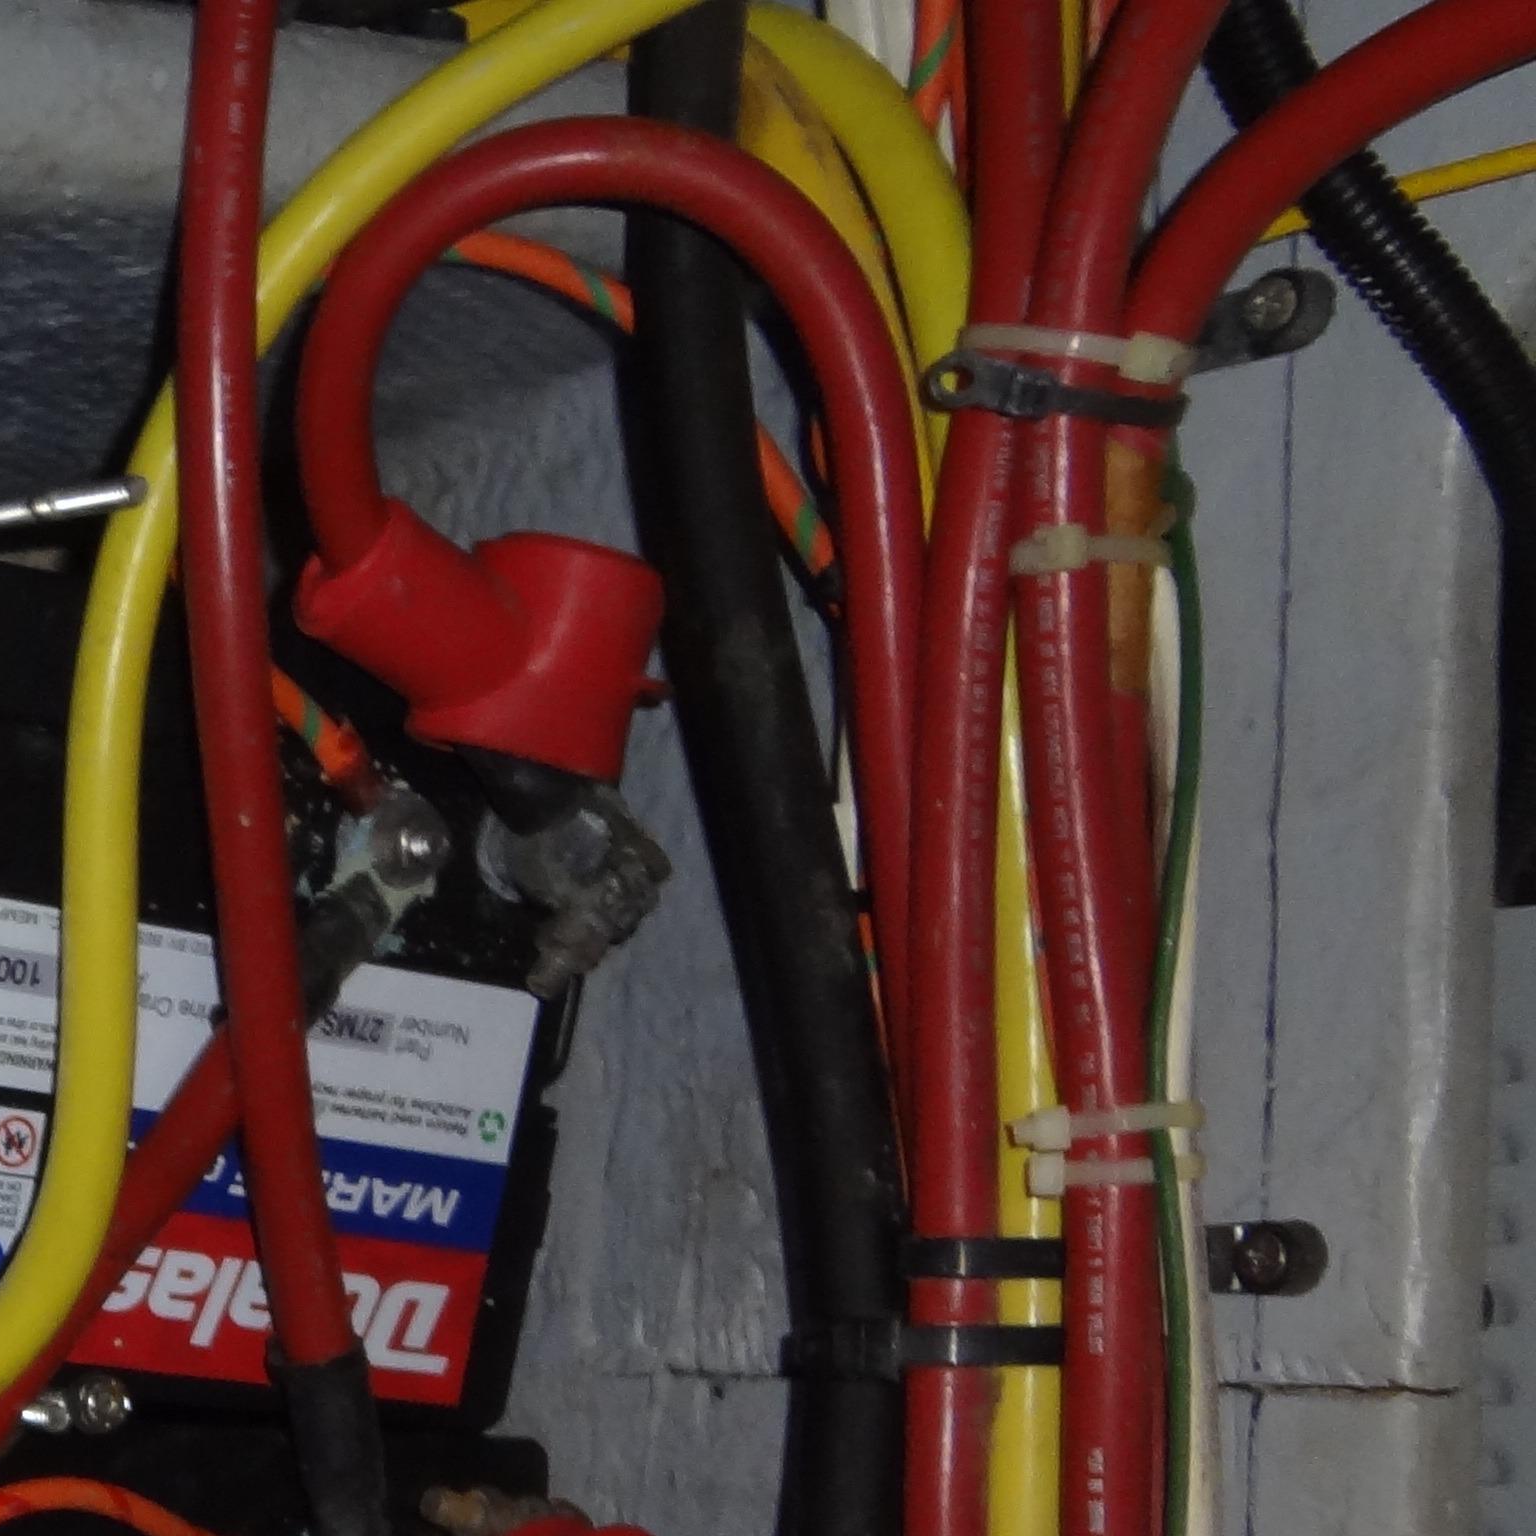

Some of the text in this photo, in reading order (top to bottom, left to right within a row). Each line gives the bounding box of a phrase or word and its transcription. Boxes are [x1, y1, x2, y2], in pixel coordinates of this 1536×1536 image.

[397, 1014, 472, 1048] Number
[393, 1036, 434, 1063] Part
[95, 1240, 463, 1377] Dualas
